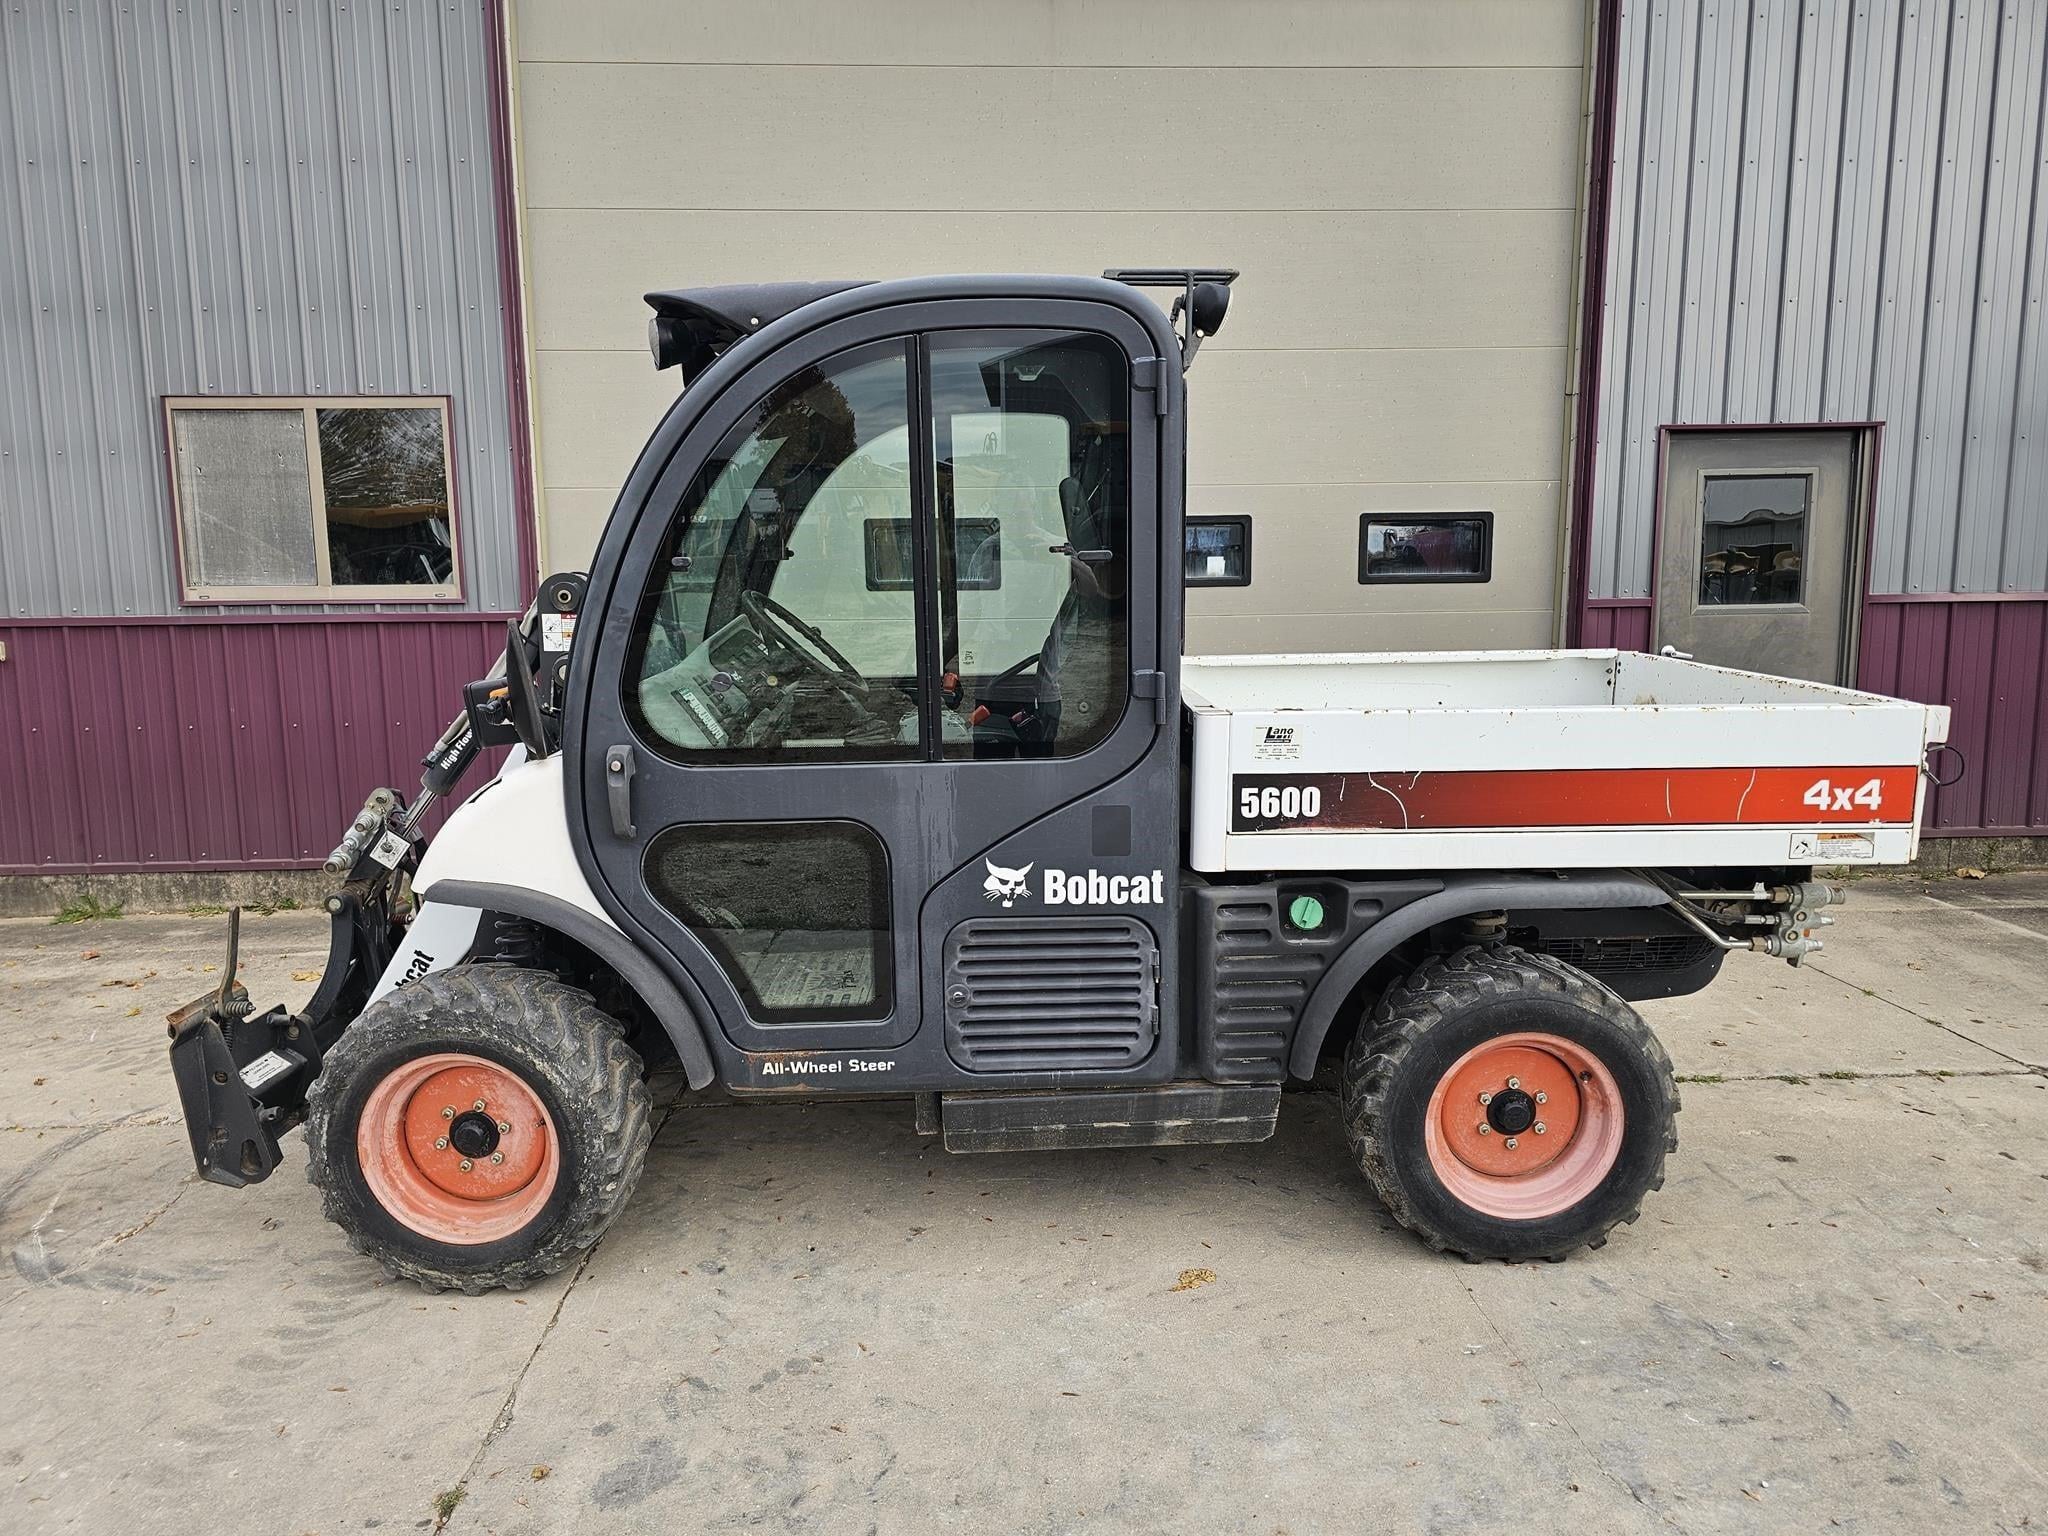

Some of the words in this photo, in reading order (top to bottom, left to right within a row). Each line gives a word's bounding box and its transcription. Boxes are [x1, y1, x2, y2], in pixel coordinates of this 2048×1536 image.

[1265, 726, 1294, 739] Lano
[440, 749, 460, 770] High
[1240, 786, 1321, 818] 5600
[1803, 778, 1882, 811] 4x4
[1043, 868, 1164, 904] Bobcat
[762, 1061, 842, 1075] All-Wheel
[849, 1059, 895, 1072] Steer
